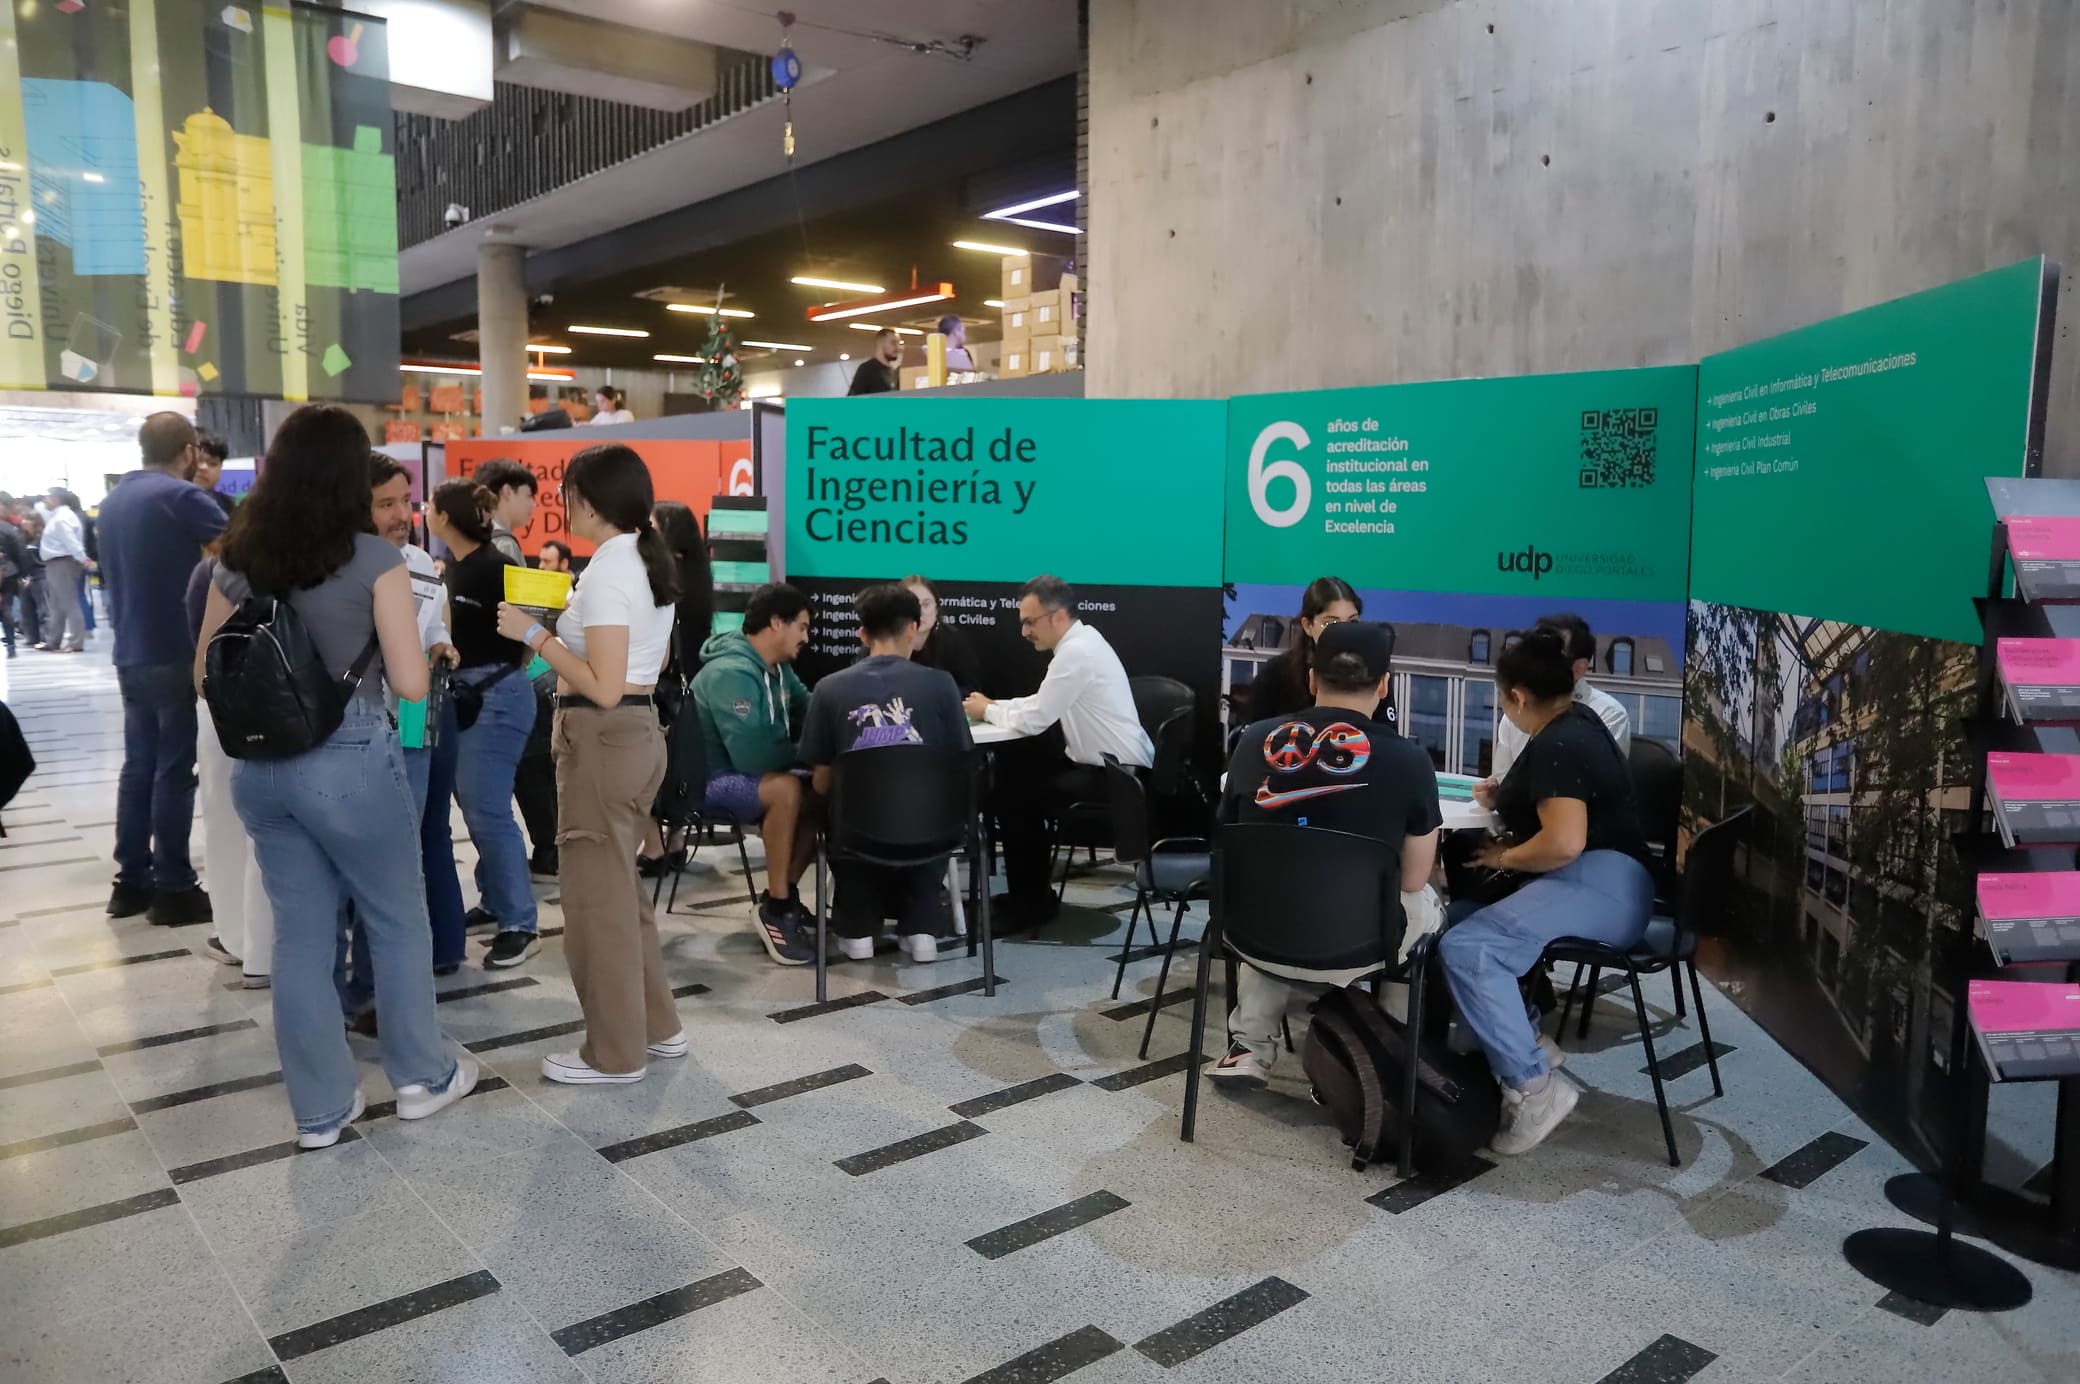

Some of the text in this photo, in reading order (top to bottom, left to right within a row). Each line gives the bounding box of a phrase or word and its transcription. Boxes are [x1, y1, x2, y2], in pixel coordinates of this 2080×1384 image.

[1743, 384, 1758, 400] Civil
[1759, 387, 1768, 396] en
[1770, 371, 1812, 394] Informática
[1813, 374, 1819, 388] y
[1821, 351, 1917, 383] Telecomunicaciones
[1743, 410, 1757, 425] Civil
[1758, 412, 1767, 422] en
[1769, 406, 1790, 421] Obras
[1792, 400, 1816, 416] Civiles
[1327, 417, 1379, 433] años de
[807, 426, 1037, 463] Facultad de
[1327, 437, 1408, 454] acreditación
[1742, 436, 1756, 450] Civil
[1757, 431, 1791, 448] Industrial
[1248, 420, 1312, 527] 6
[1326, 458, 1429, 473] institucional en
[1741, 461, 1755, 475] Civil
[1756, 461, 1771, 474] Plan
[1772, 457, 1798, 473] Común
[807, 467, 1036, 514] Ingeniería y
[1326, 478, 1427, 493] todas las áreas
[1325, 499, 1397, 513] en nivel de
[806, 508, 968, 545] Ciencias
[1325, 520, 1394, 533] Excelencia
[1498, 545, 1553, 580] udp
[990, 599, 997, 610] y
[959, 614, 995, 626] Civiles
